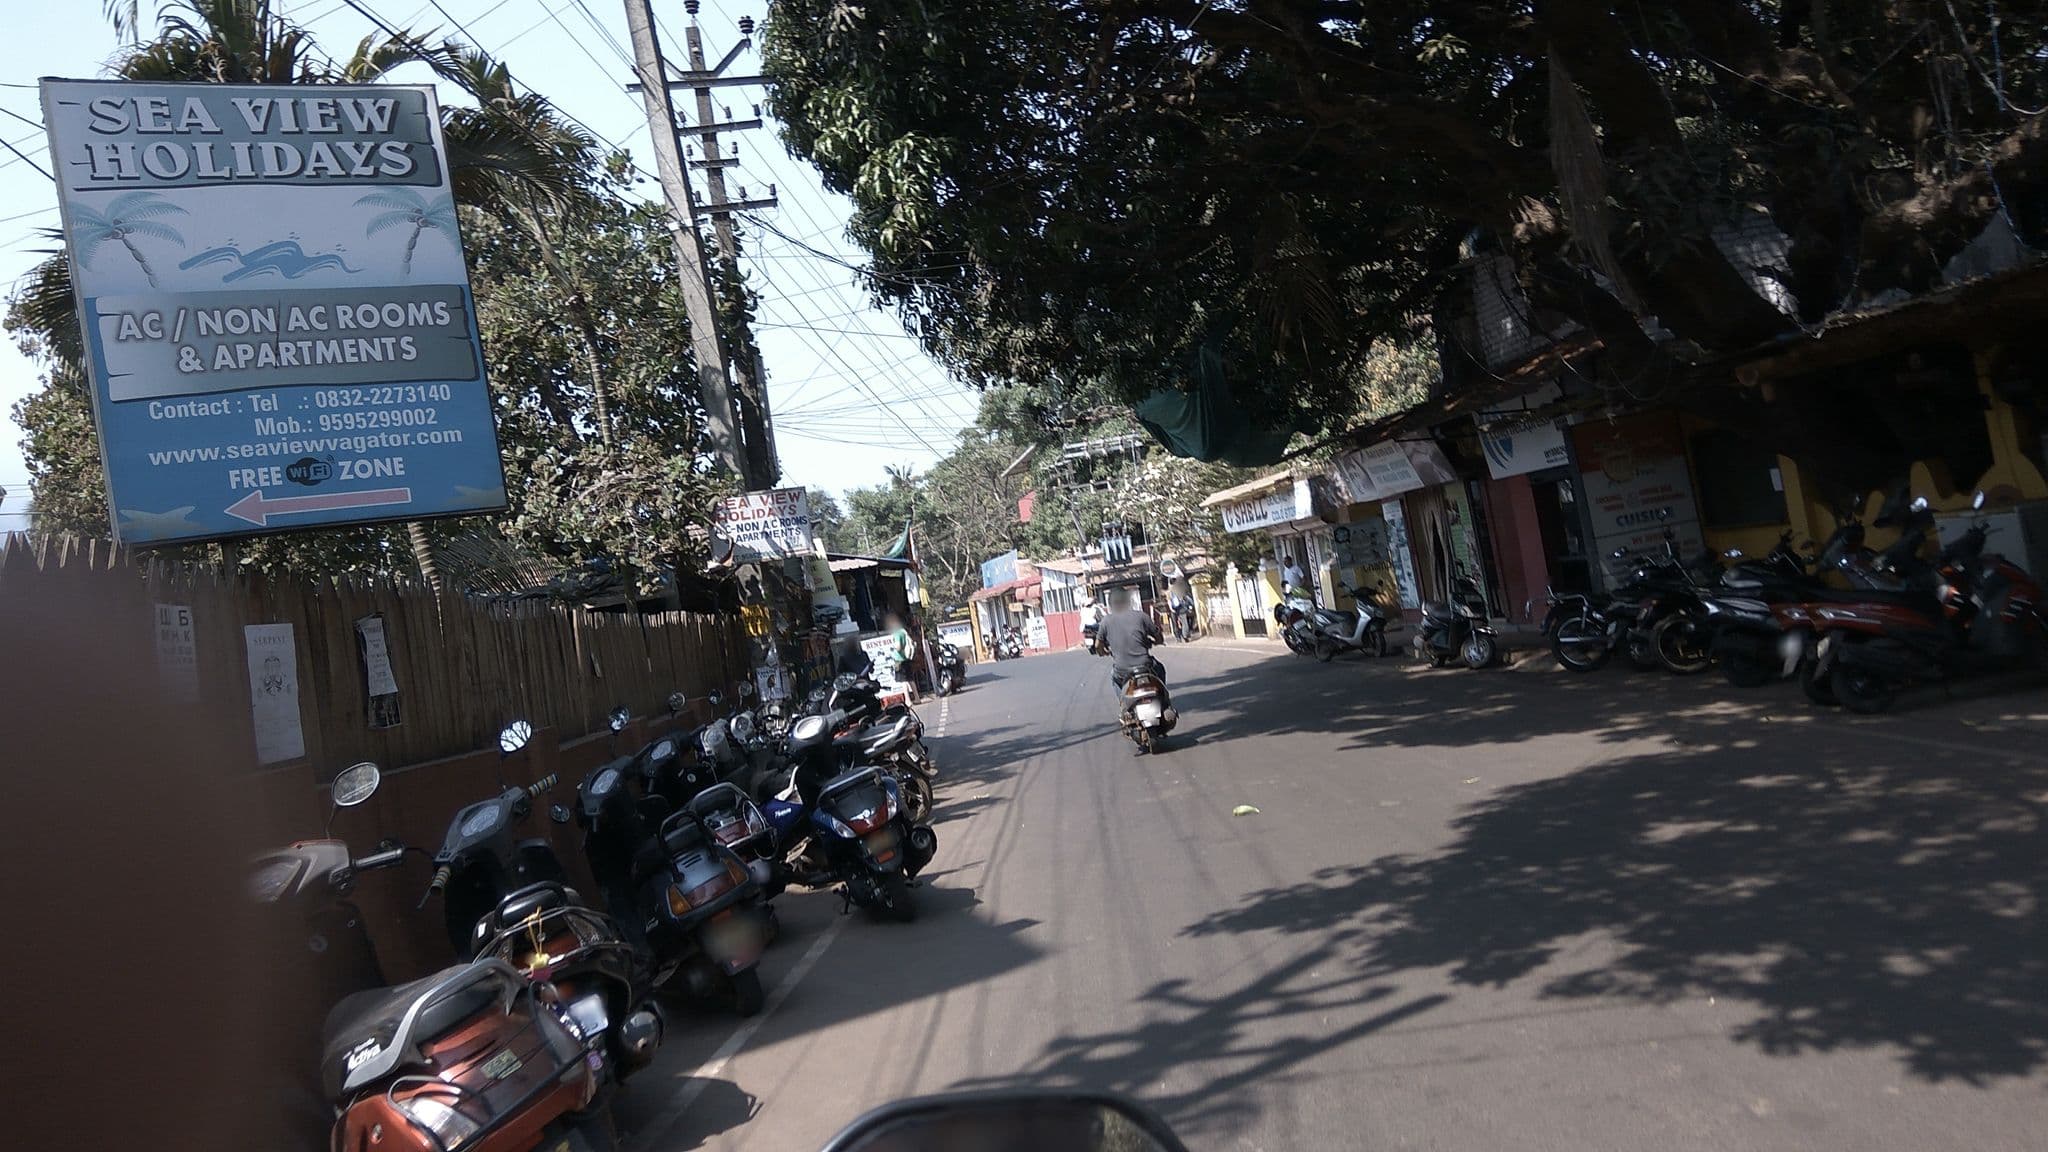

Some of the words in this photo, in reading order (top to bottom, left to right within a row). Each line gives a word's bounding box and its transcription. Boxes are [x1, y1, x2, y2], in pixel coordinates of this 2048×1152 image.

[88, 96, 220, 135] SEA
[231, 96, 400, 134] VIEW
[84, 140, 414, 180] HOLIDAYS
[118, 312, 163, 341] AC
[197, 307, 277, 336] NON
[287, 305, 329, 332] AC
[336, 301, 451, 329] ROOMS
[178, 346, 204, 373] &
[213, 335, 418, 371] APARTMENTS
[149, 398, 231, 420] Contact
[247, 393, 279, 412] Tel
[314, 383, 451, 409] 0832-2273140
[318, 407, 438, 432] 9595299002
[148, 429, 463, 466] www.seaviewvagator.com
[228, 466, 283, 490] FREE
[338, 456, 406, 481] ZONE
[716, 504, 797, 523] HOLIDAYS
[760, 491, 801, 507] VIEW
[735, 527, 801, 543] APARTMENTS
[780, 515, 808, 527] ROOMS
